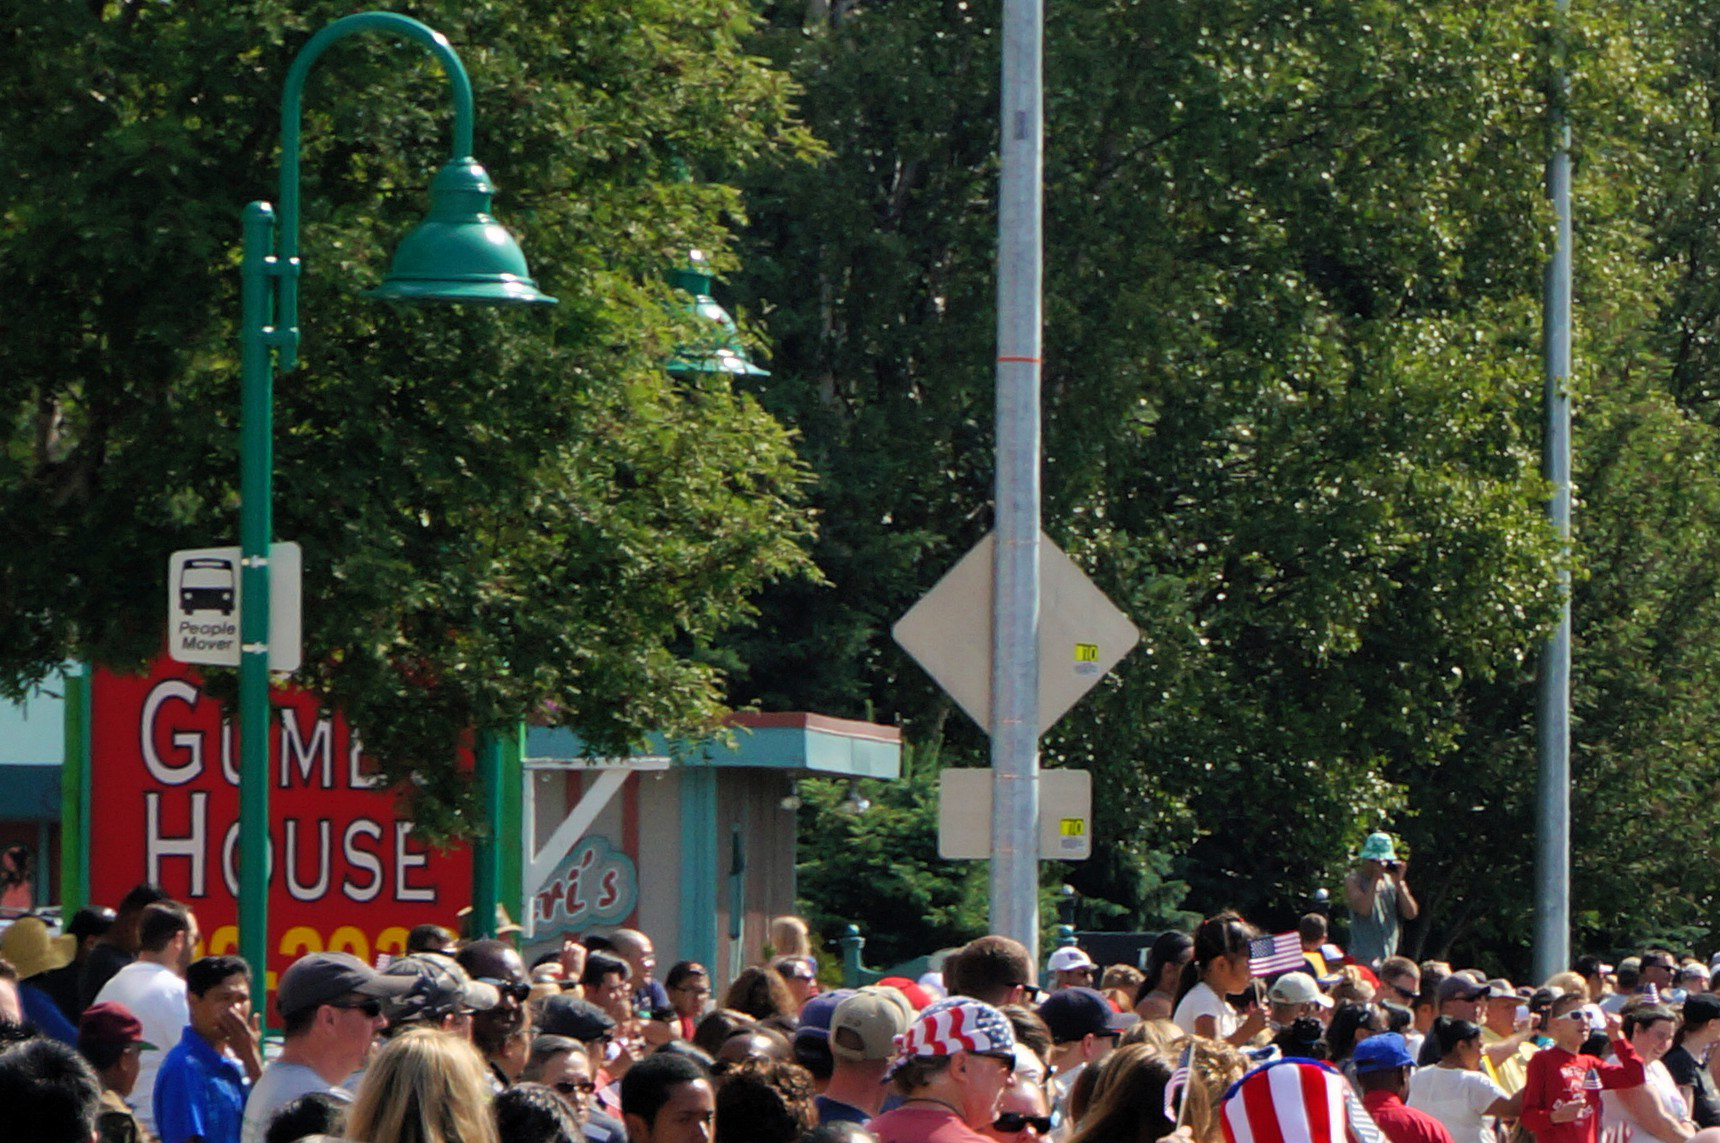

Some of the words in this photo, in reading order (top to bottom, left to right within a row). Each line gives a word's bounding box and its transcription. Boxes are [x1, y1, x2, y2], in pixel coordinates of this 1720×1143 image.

[180, 621, 236, 637] People
[182, 636, 234, 650] Mover
[534, 849, 619, 921] ri's
